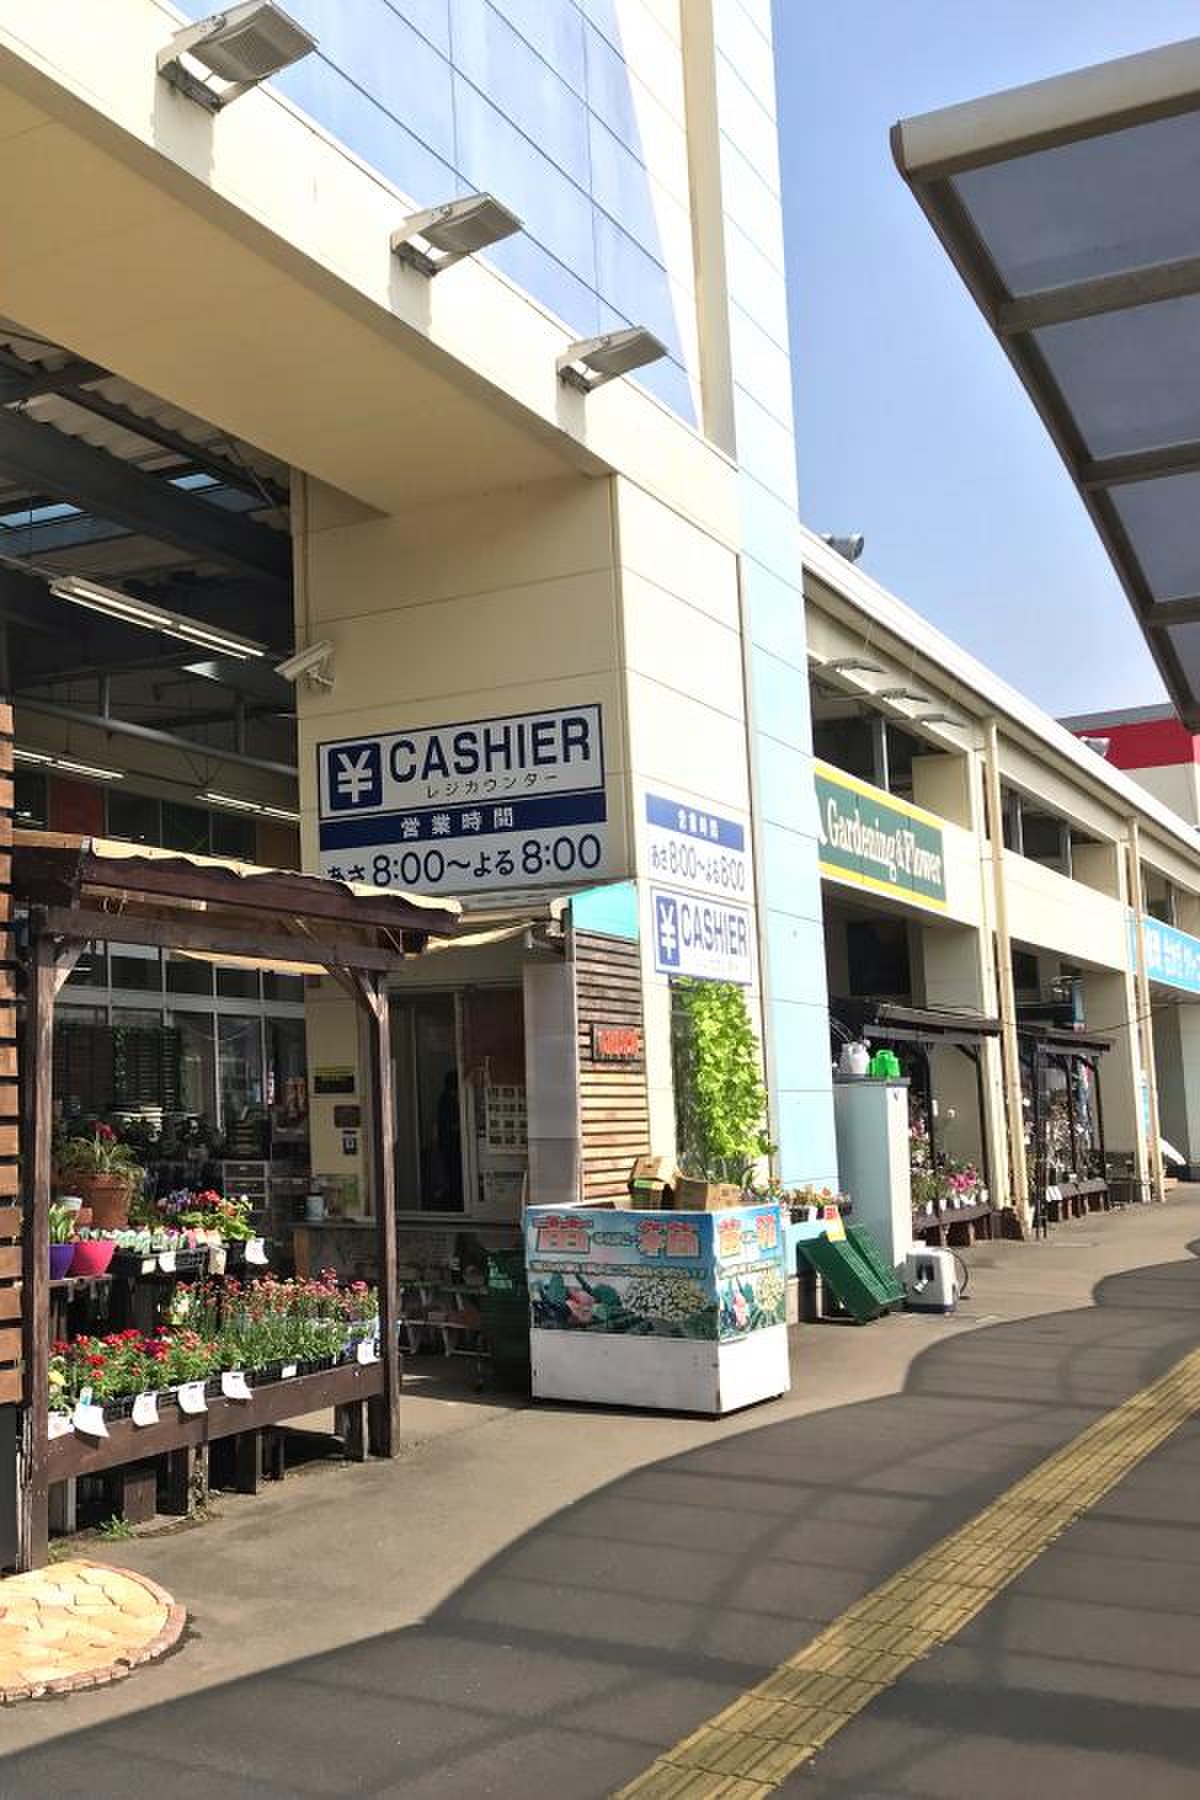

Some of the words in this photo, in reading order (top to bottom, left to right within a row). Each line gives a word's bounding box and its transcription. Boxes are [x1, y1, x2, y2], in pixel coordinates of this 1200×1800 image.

[389, 716, 591, 782] CASHIER
[427, 772, 559, 800] レジカウンター
[400, 807, 513, 839] 営業時間
[681, 903, 748, 957] CASHIER
